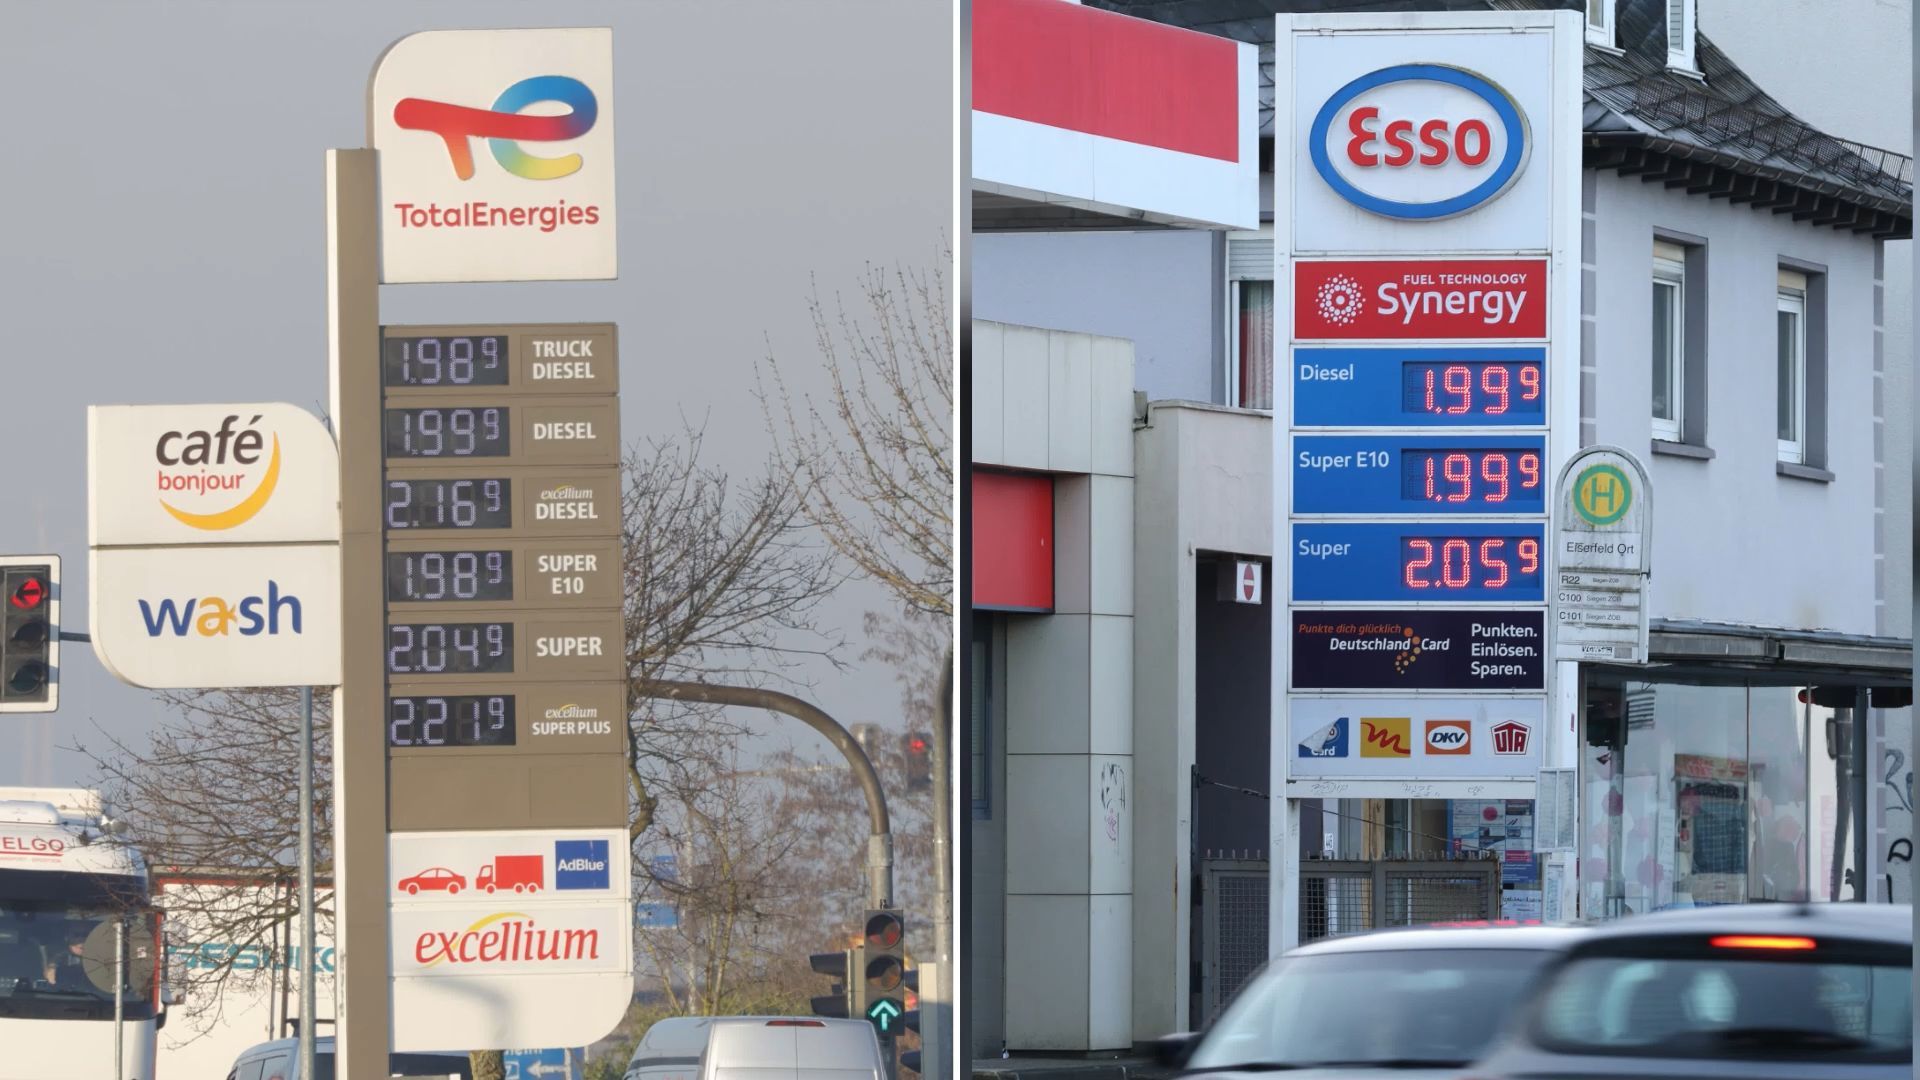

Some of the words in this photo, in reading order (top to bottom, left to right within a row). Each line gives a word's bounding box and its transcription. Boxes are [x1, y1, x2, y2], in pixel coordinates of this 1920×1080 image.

[394, 199, 599, 232] TotalEnergies
[1403, 275, 1435, 285] FUEL
[1439, 273, 1527, 285] TECHNOLOGY
[1377, 282, 1527, 324] Synergy
[532, 340, 592, 357] TRUCK
[532, 362, 595, 379] DIESEL
[1300, 364, 1354, 380] Diesel
[533, 422, 596, 440] DIESEL
[155, 414, 263, 466] café
[1299, 451, 1351, 472] Super
[1356, 451, 1389, 468] E10
[158, 469, 245, 495] bonjour
[540, 485, 593, 500] excellium
[535, 502, 598, 520] DIESEL
[1299, 539, 1351, 560] Super
[1617, 543, 1634, 555] Ort
[538, 555, 597, 573] SUPER
[551, 577, 584, 595] E10
[1561, 575, 1580, 585] R22
[1559, 592, 1582, 602] C100
[137, 579, 302, 637] wash
[1559, 611, 1581, 620] C101
[1299, 624, 1334, 633] Punkte
[1336, 624, 1357, 633] dich
[1358, 624, 1402, 635] glücklich
[1471, 623, 1538, 638] Punkten.
[536, 636, 602, 657] SUPER
[1330, 638, 1411, 650] Deutschland
[1421, 638, 1450, 651] Card
[1471, 643, 1538, 657] Einlösen.
[1470, 662, 1527, 678] Sparen.
[545, 704, 597, 718] excellium
[532, 721, 578, 735] SUPER
[578, 721, 611, 735] PLUS
[1431, 732, 1466, 743] DKV
[1494, 722, 1528, 752] UTA
[557, 858, 605, 872] AdBlue
[415, 918, 599, 963] excellium
